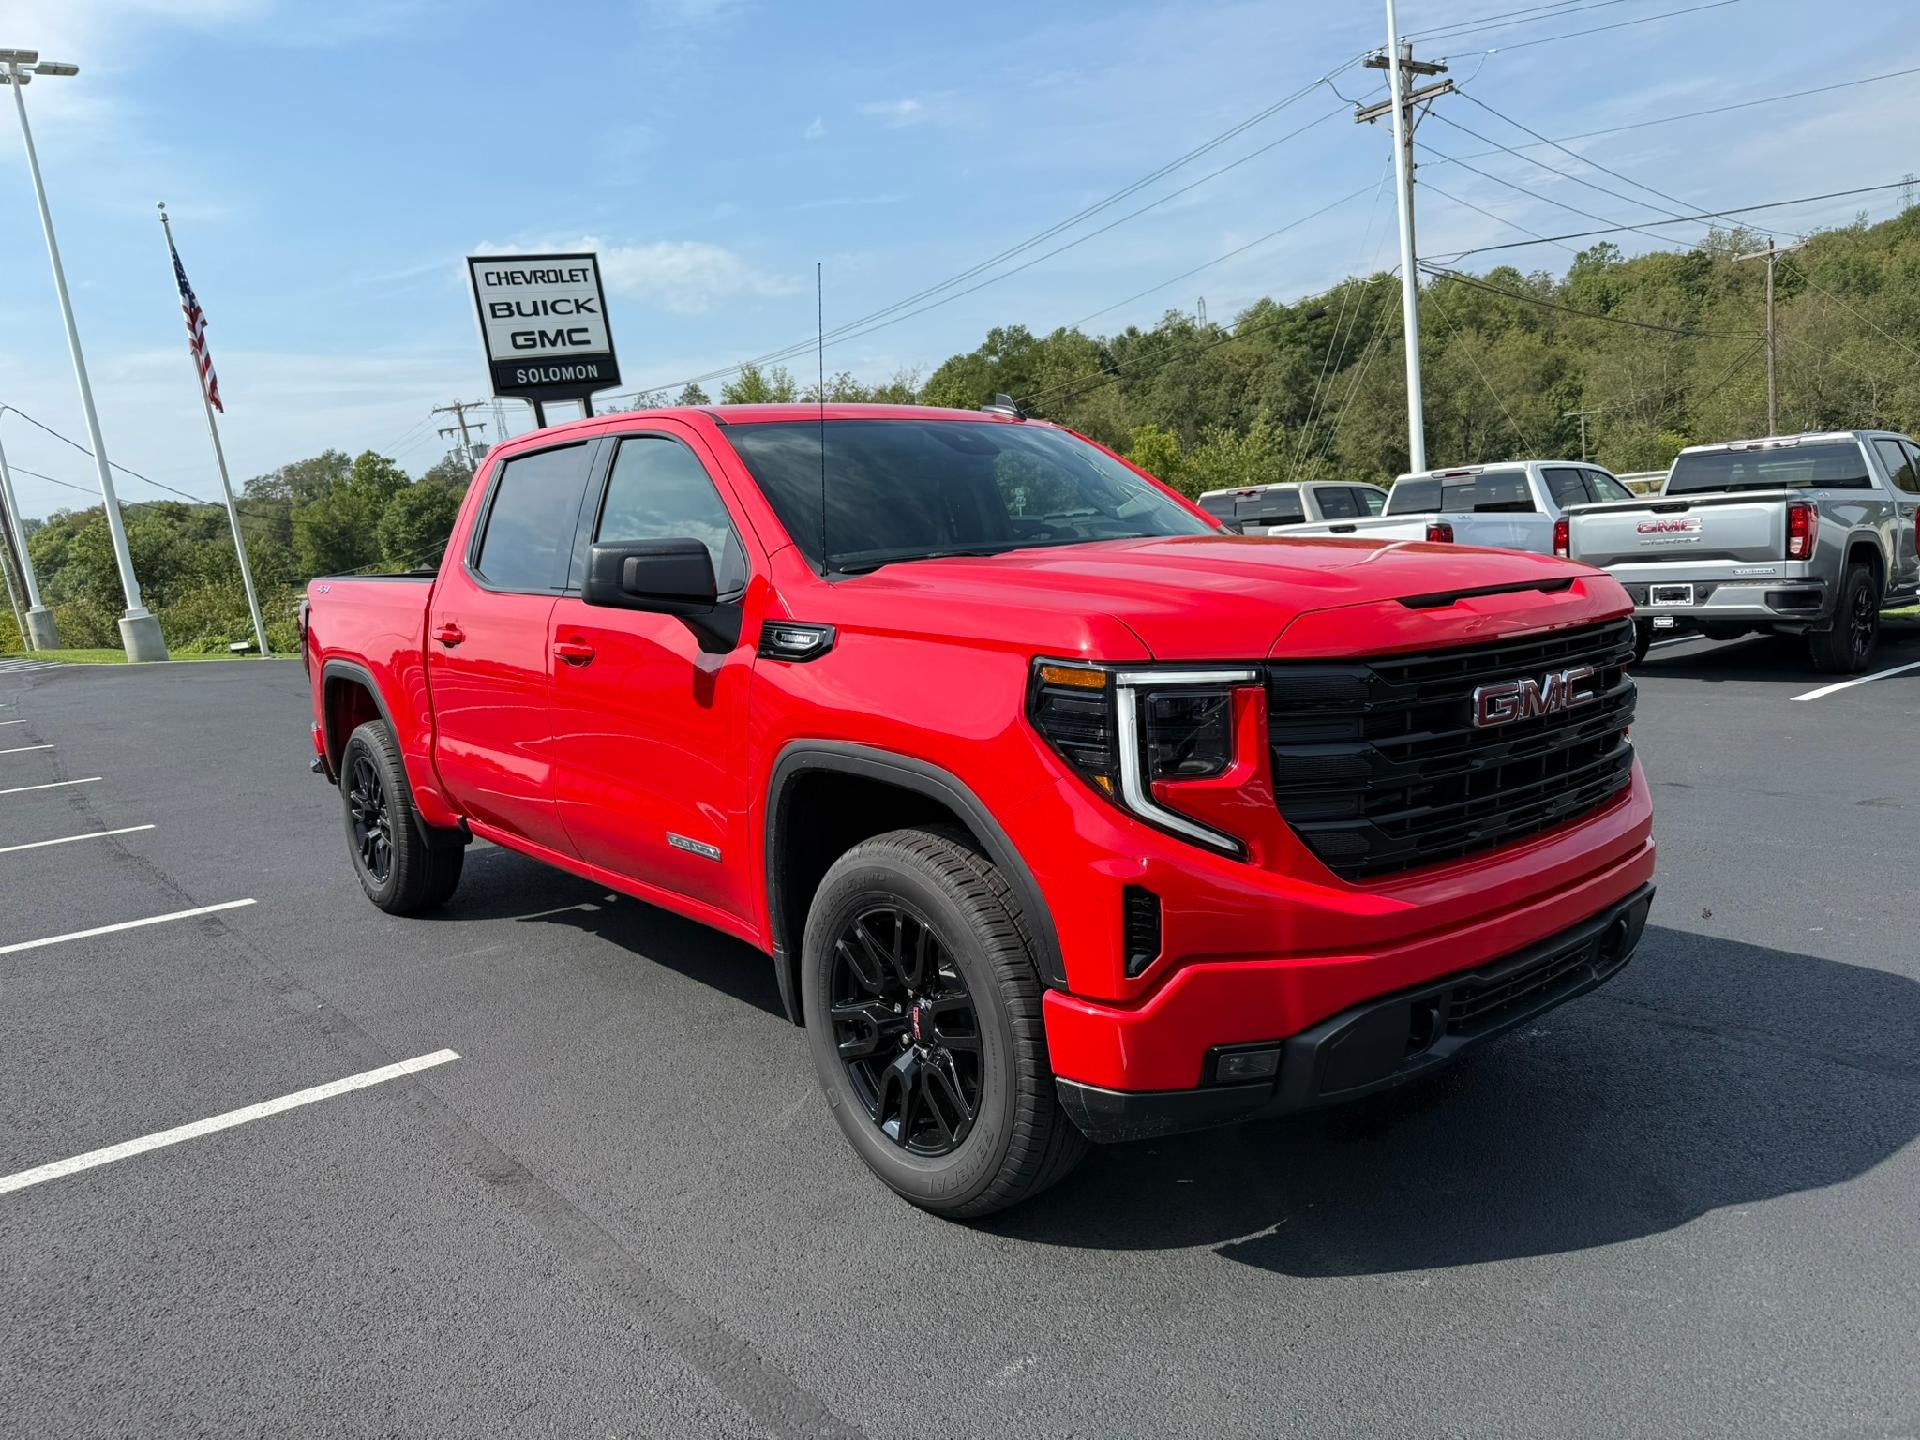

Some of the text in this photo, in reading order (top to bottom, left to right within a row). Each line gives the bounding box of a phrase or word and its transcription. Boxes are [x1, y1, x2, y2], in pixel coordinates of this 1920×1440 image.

[485, 268, 589, 286] CHEVROLET
[488, 298, 598, 319] BUICK
[511, 328, 591, 350] GMC
[517, 365, 598, 384] SOLOMON
[1636, 518, 1703, 535] GMC
[1473, 666, 1595, 728] GMC
